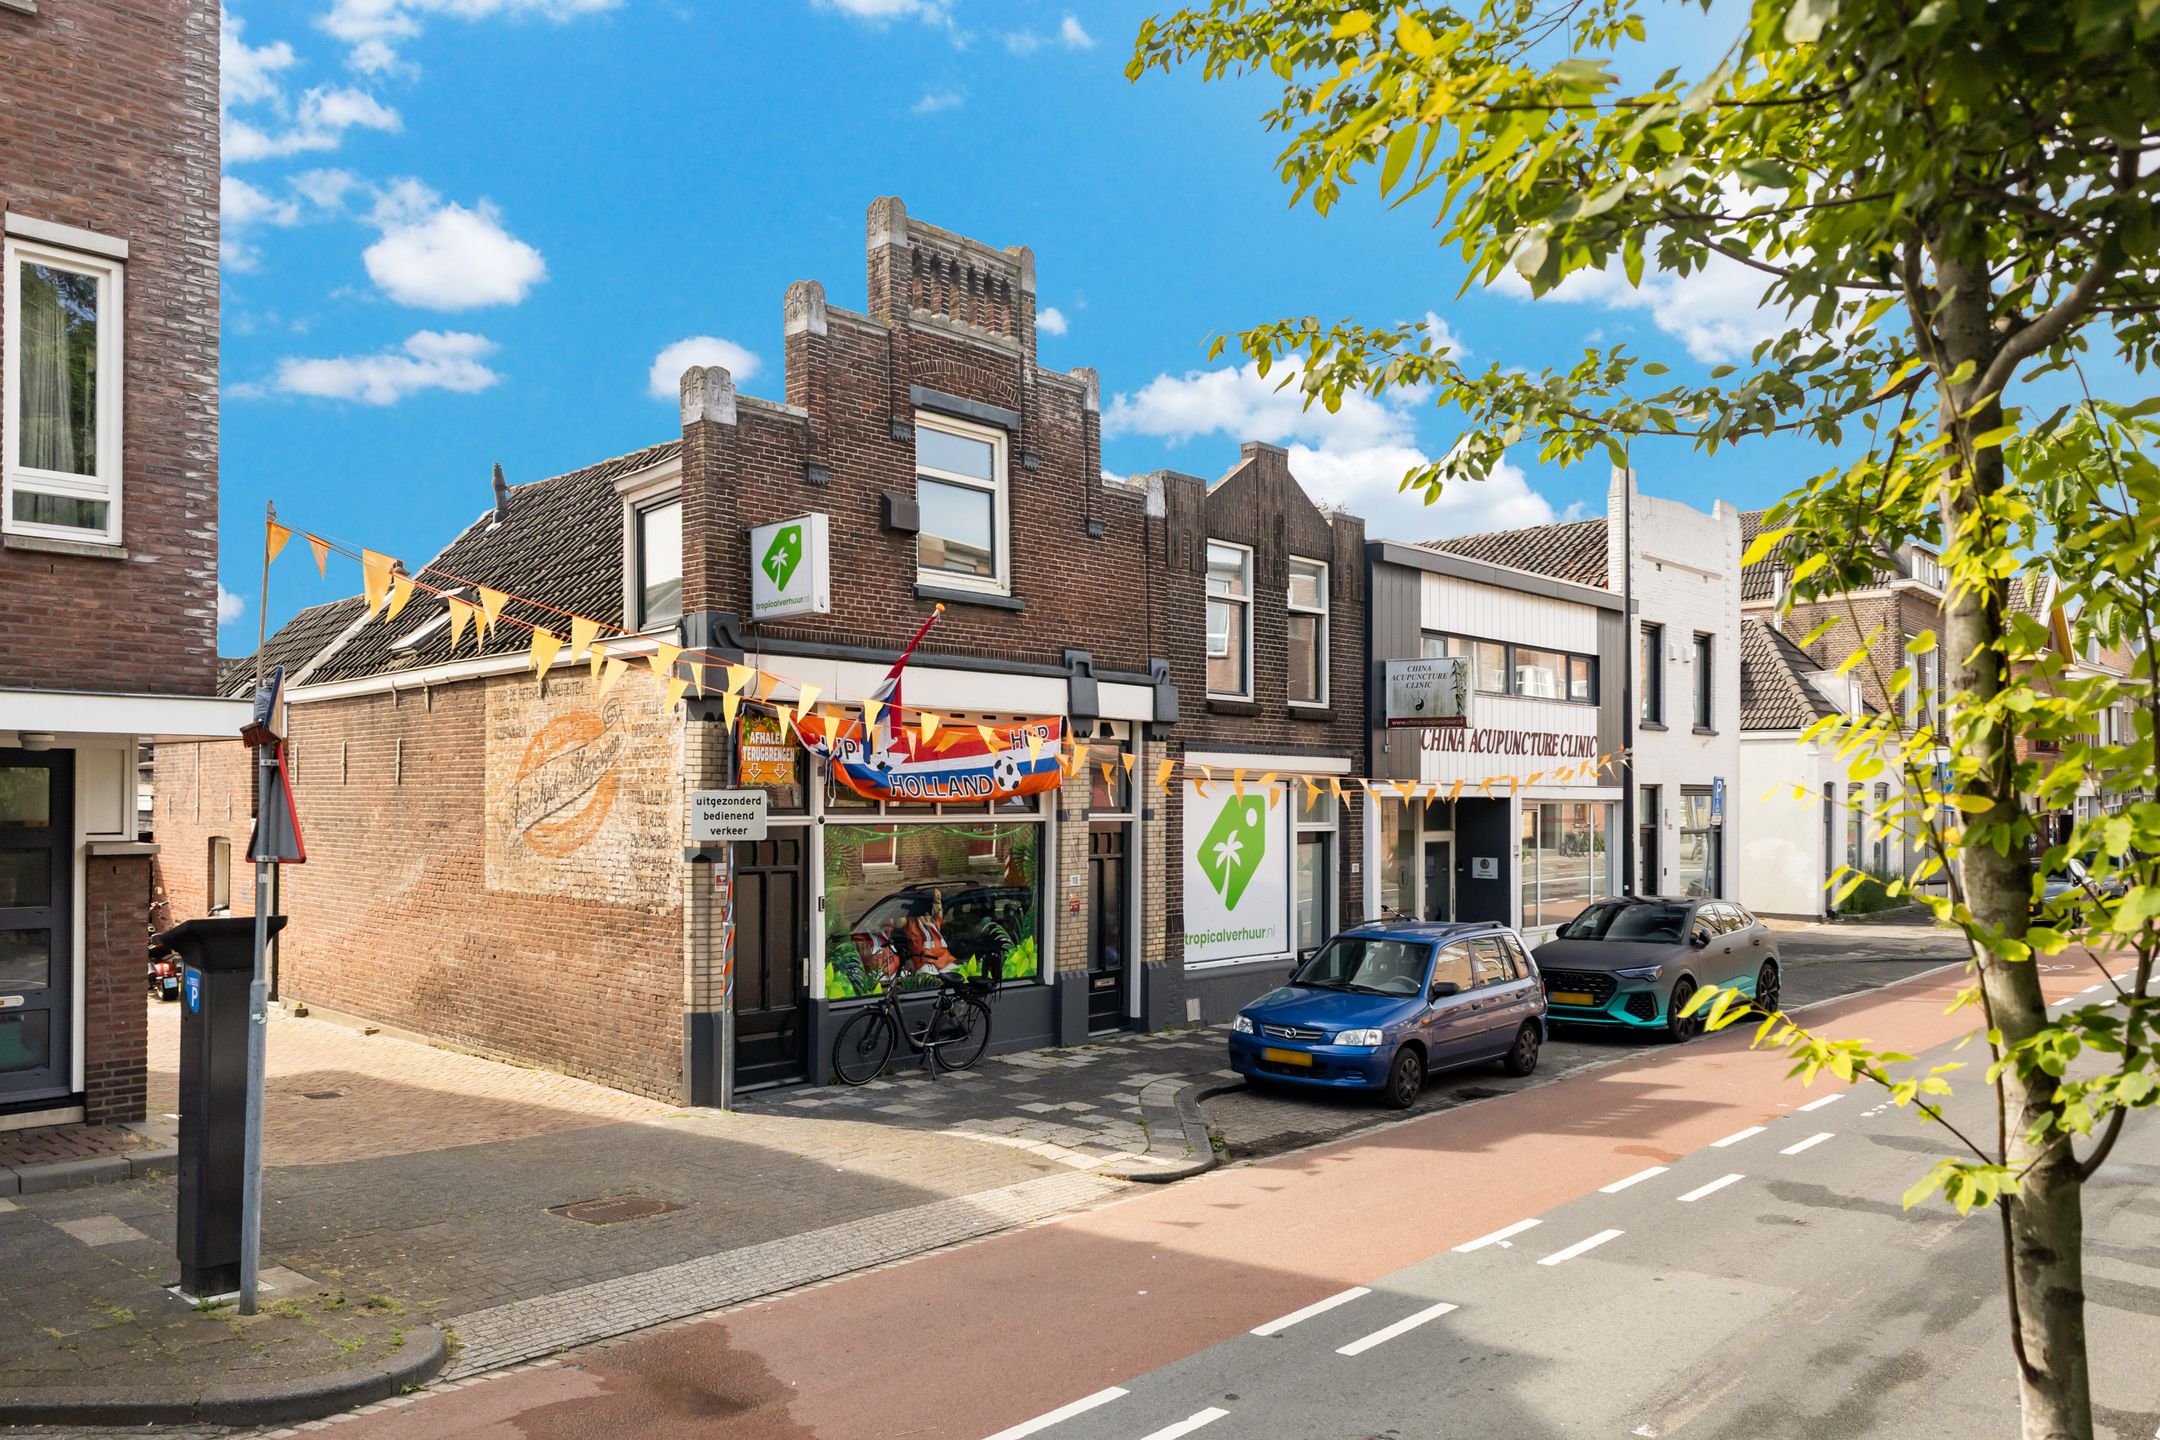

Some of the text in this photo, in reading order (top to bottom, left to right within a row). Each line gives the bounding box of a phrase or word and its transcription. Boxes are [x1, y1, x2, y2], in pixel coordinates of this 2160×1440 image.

[1407, 665, 1432, 673] CHINA
[1391, 672, 1448, 681] ACUPUNCTURE
[1405, 681, 1433, 689] CLINIC
[1421, 728, 1598, 758] CHINA ACUPUNCTURE CLINIC
[742, 745, 795, 762] TERUGBRENGEN
[888, 774, 994, 798] HOLLAND
[696, 796, 762, 809] uitgezonderd
[703, 811, 754, 820] bedienend
[710, 826, 748, 835] verkeer
[1184, 924, 1275, 949] tropicalverhuur.nl
[191, 986, 198, 1007] P
